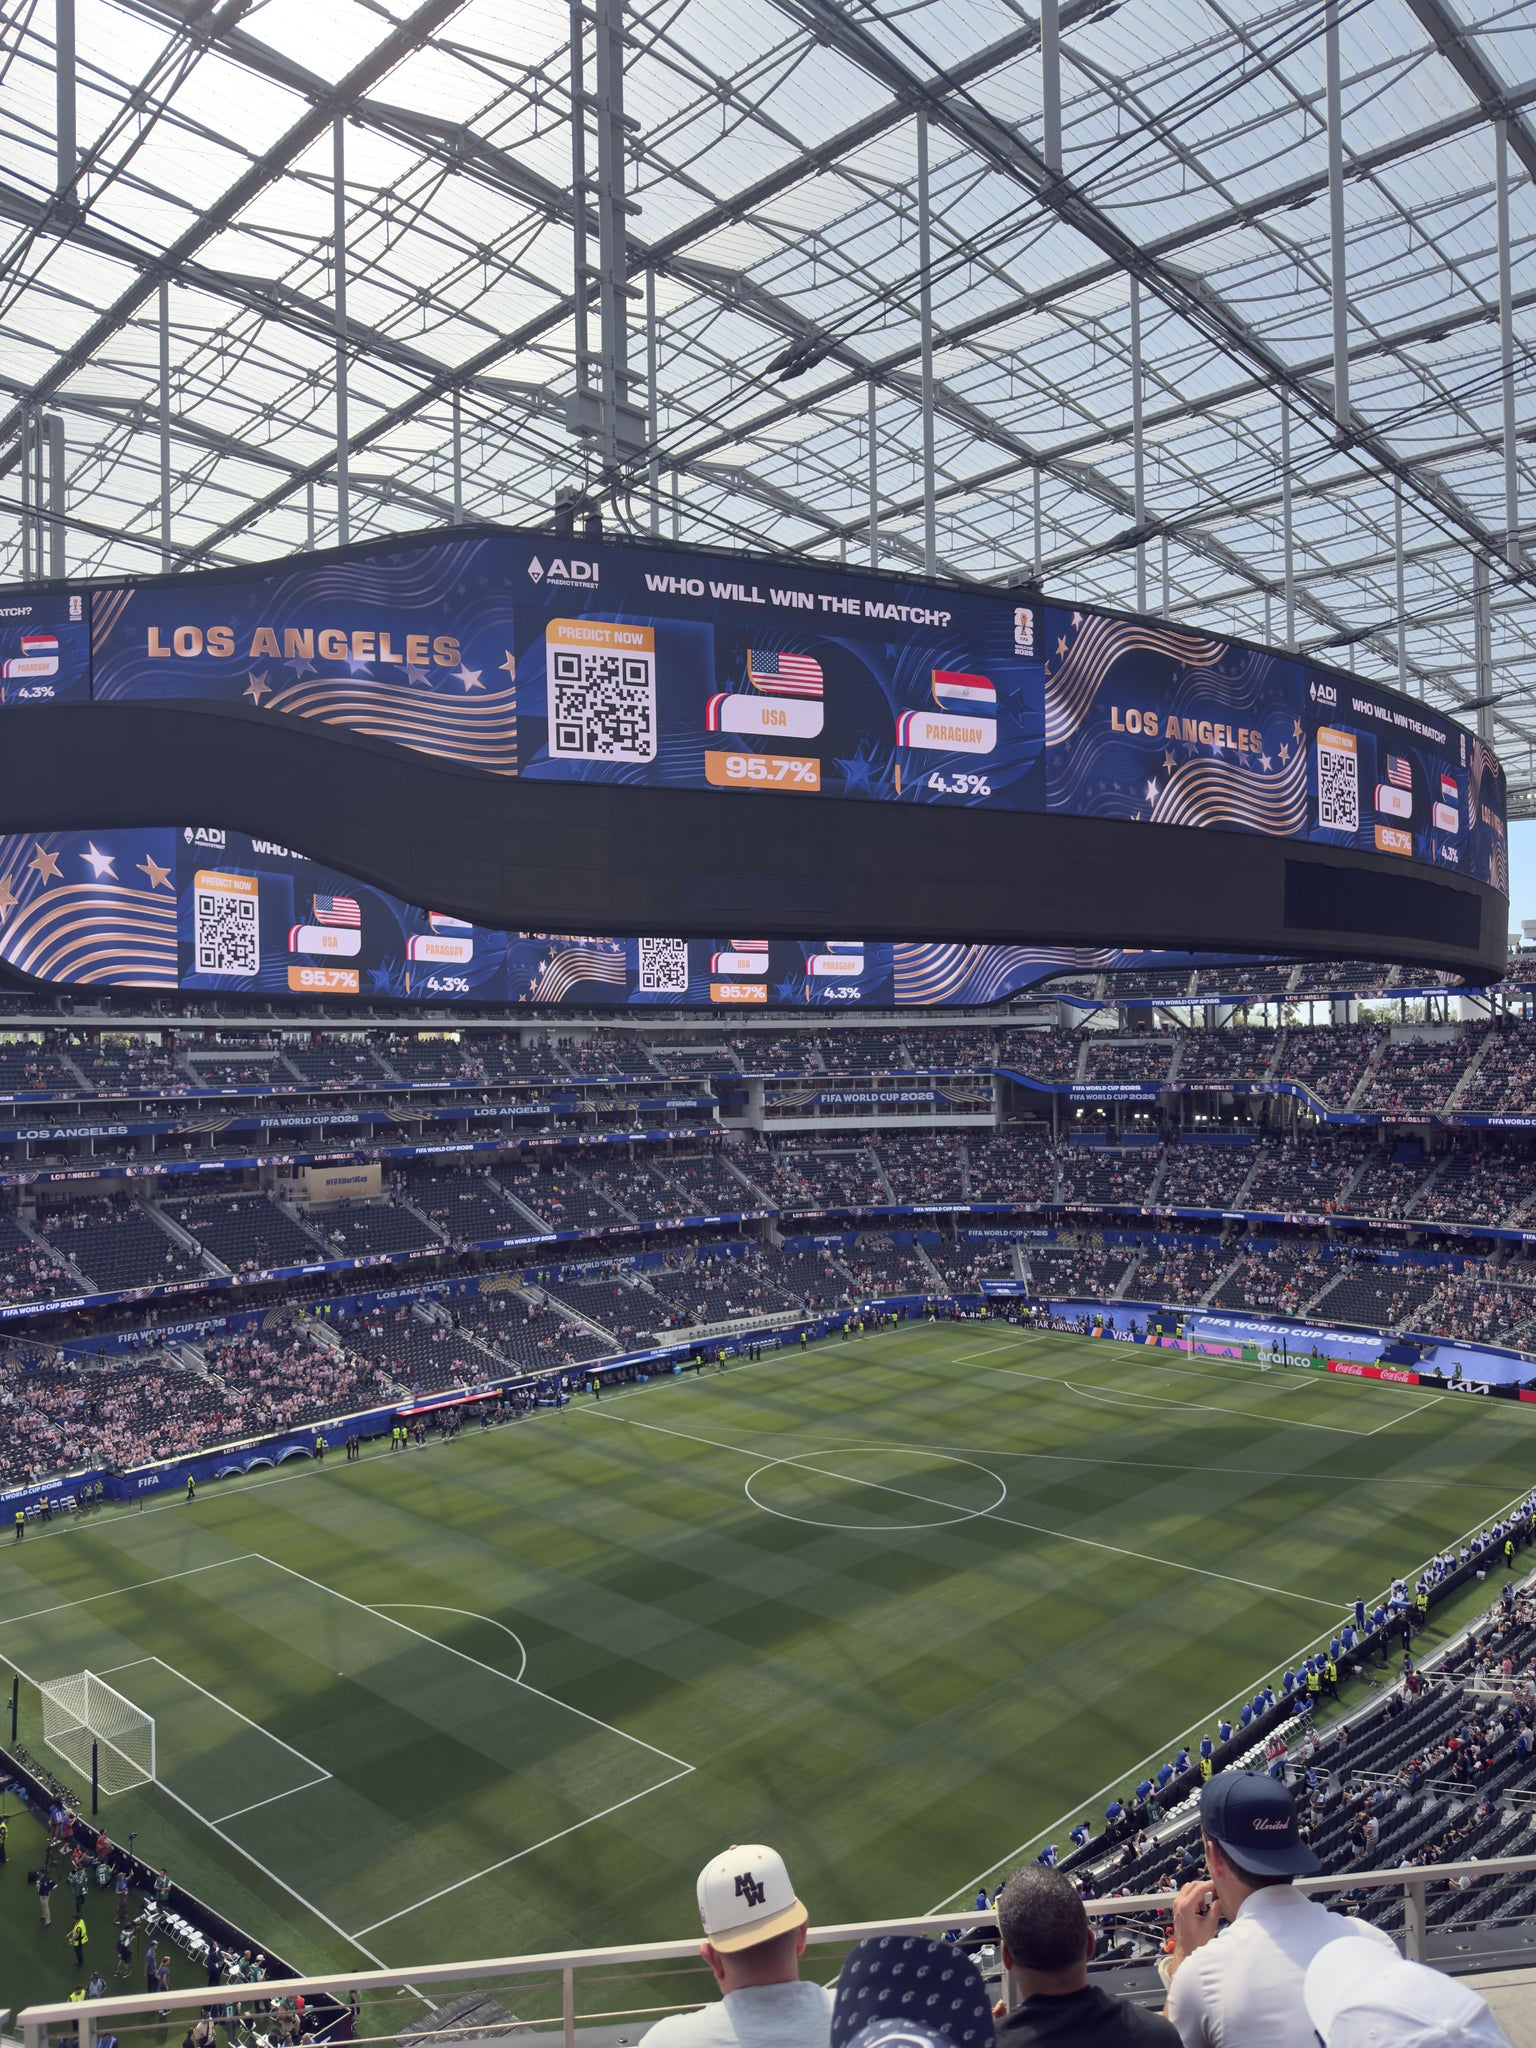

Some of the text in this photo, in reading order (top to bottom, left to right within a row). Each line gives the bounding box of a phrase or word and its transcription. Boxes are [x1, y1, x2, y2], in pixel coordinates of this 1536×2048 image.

[547, 558, 599, 582] ADI
[547, 578, 599, 589] PREDICTSTREET
[645, 574, 951, 628] WHO WILL WIN THE MATCH?
[0, 606, 33, 617] ATCH?
[558, 626, 643, 645] PREDICT NOW
[148, 626, 461, 667] LOS ANGELES
[18, 662, 50, 673] PARAGUAY
[18, 686, 56, 698] 4.3%
[1317, 684, 1337, 702] ADI
[762, 708, 787, 727] USA
[1352, 698, 1373, 716] WHO
[1374, 705, 1393, 723] WILL
[1394, 712, 1408, 729] WIN
[1408, 718, 1422, 734] THE
[1422, 724, 1447, 745] MATCH?
[926, 724, 983, 744] PARAGUAY
[1110, 706, 1262, 753] LOS ANGELES
[726, 756, 817, 783] 95.7%
[928, 772, 991, 796] 4.3%
[195, 828, 226, 844] ADI
[1381, 829, 1411, 851] 95.7%
[1442, 846, 1459, 863] 4.3%
[201, 876, 252, 891] PREDICT NOW
[322, 936, 338, 948] USA
[425, 944, 464, 956] PARAGUAY
[738, 960, 750, 969] USA
[822, 962, 855, 971] PARAGUAY
[300, 970, 357, 988] 95.7%
[427, 976, 470, 992] 4.3%
[720, 986, 766, 998] 95.7%
[824, 986, 861, 999] 4.3%
[821, 1092, 935, 1103] FIFA WORLD CUP 2026
[1129, 1093, 1156, 1101] 2026
[474, 1106, 551, 1116] LOS ANGELES
[260, 1115, 359, 1127] FIFA WORLD CUP 2026
[1504, 1118, 1531, 1126] WORLD
[16, 1126, 129, 1140] LOS ANGELES
[164, 1285, 178, 1294] LOS
[377, 1292, 398, 1301] LOS
[3, 1299, 85, 1317] FIFA WORLD CUP 2026
[118, 1332, 138, 1344] FIFA
[176, 1324, 194, 1334] CUP
[1052, 1322, 1086, 1335] AIRWAYS
[1112, 1330, 1135, 1342] VISA
[1198, 1316, 1383, 1346] FIFA WORLD CUP 2026
[1258, 1350, 1311, 1368] aramco
[138, 1476, 159, 1488] FIFA
[6, 1488, 28, 1500] WORLD
[28, 1486, 41, 1496] CUP
[42, 1480, 63, 1491] 2026
[1252, 1816, 1292, 1832] United
